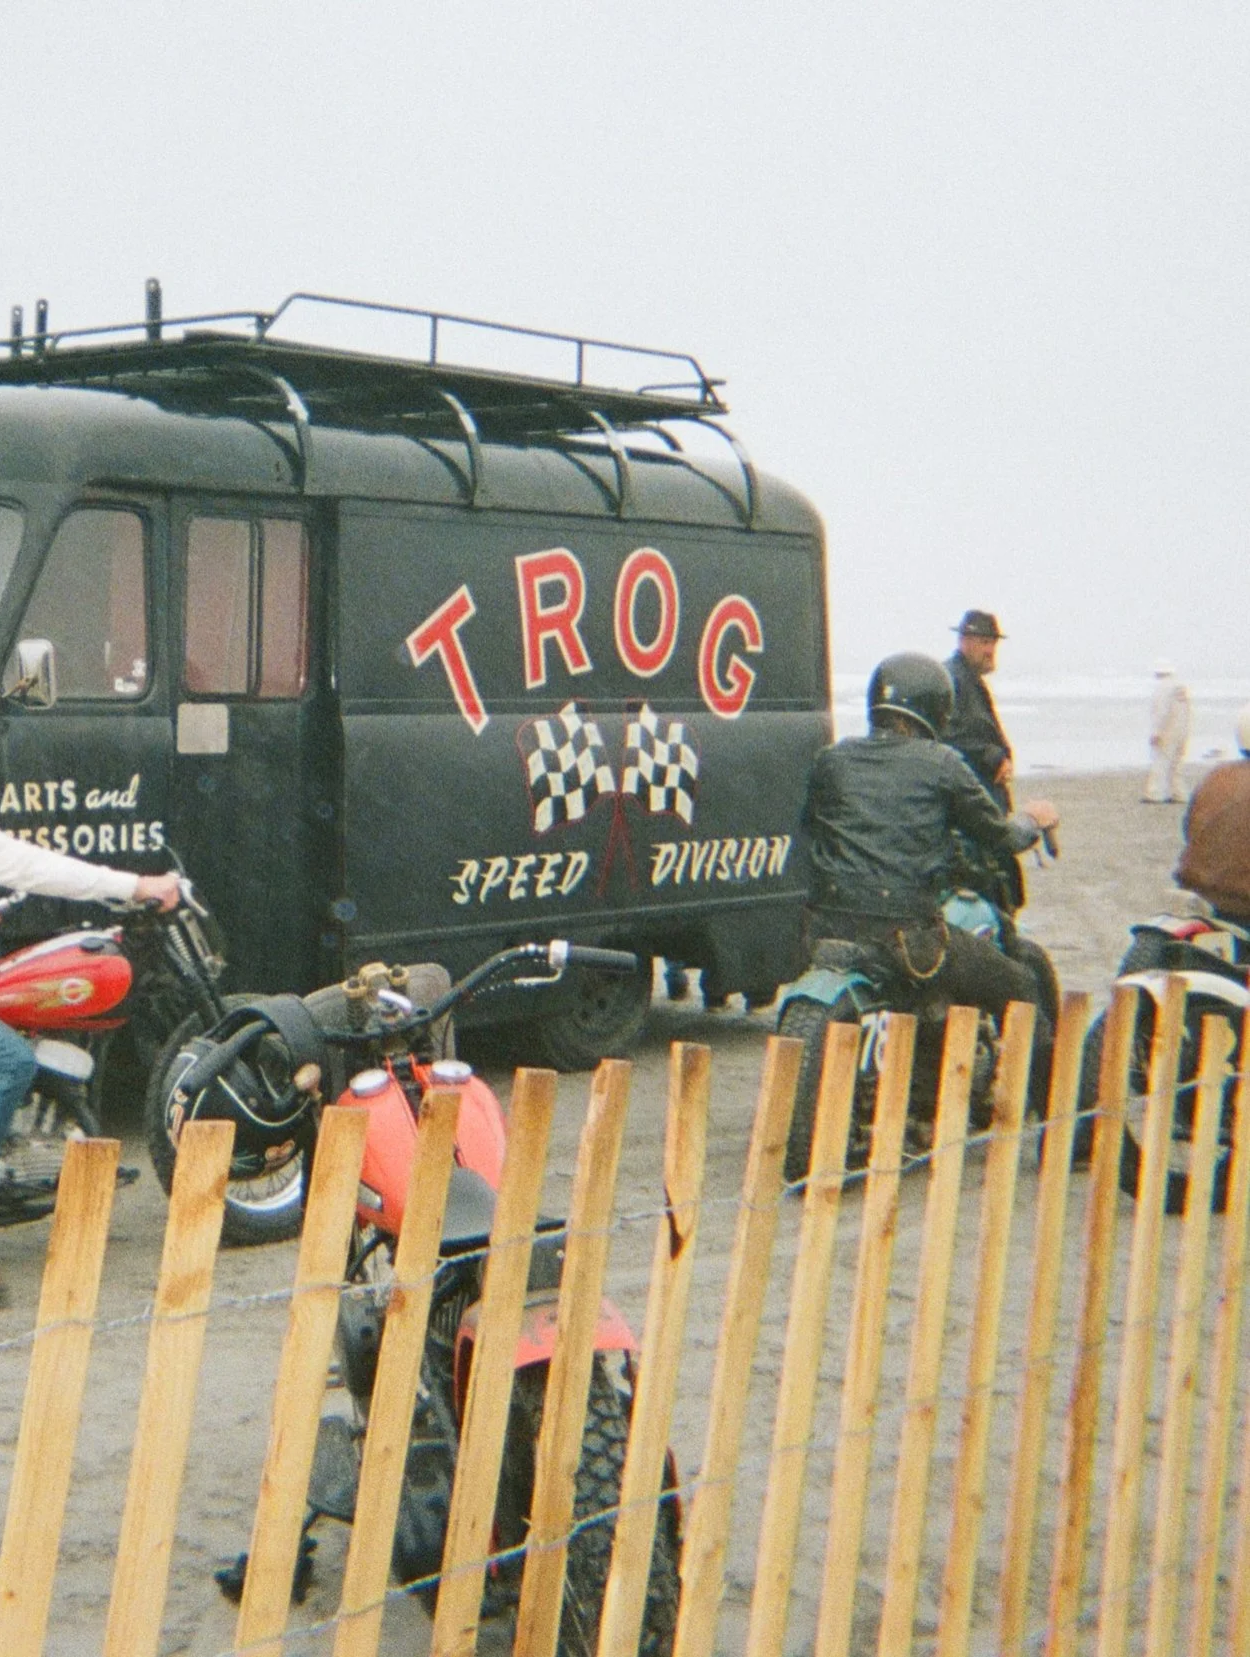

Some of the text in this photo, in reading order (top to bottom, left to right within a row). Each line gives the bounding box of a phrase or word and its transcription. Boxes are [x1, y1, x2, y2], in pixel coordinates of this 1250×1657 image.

[405, 547, 764, 736] TROG
[85, 772, 140, 810] and
[449, 834, 791, 904] SPEED DIVISION
